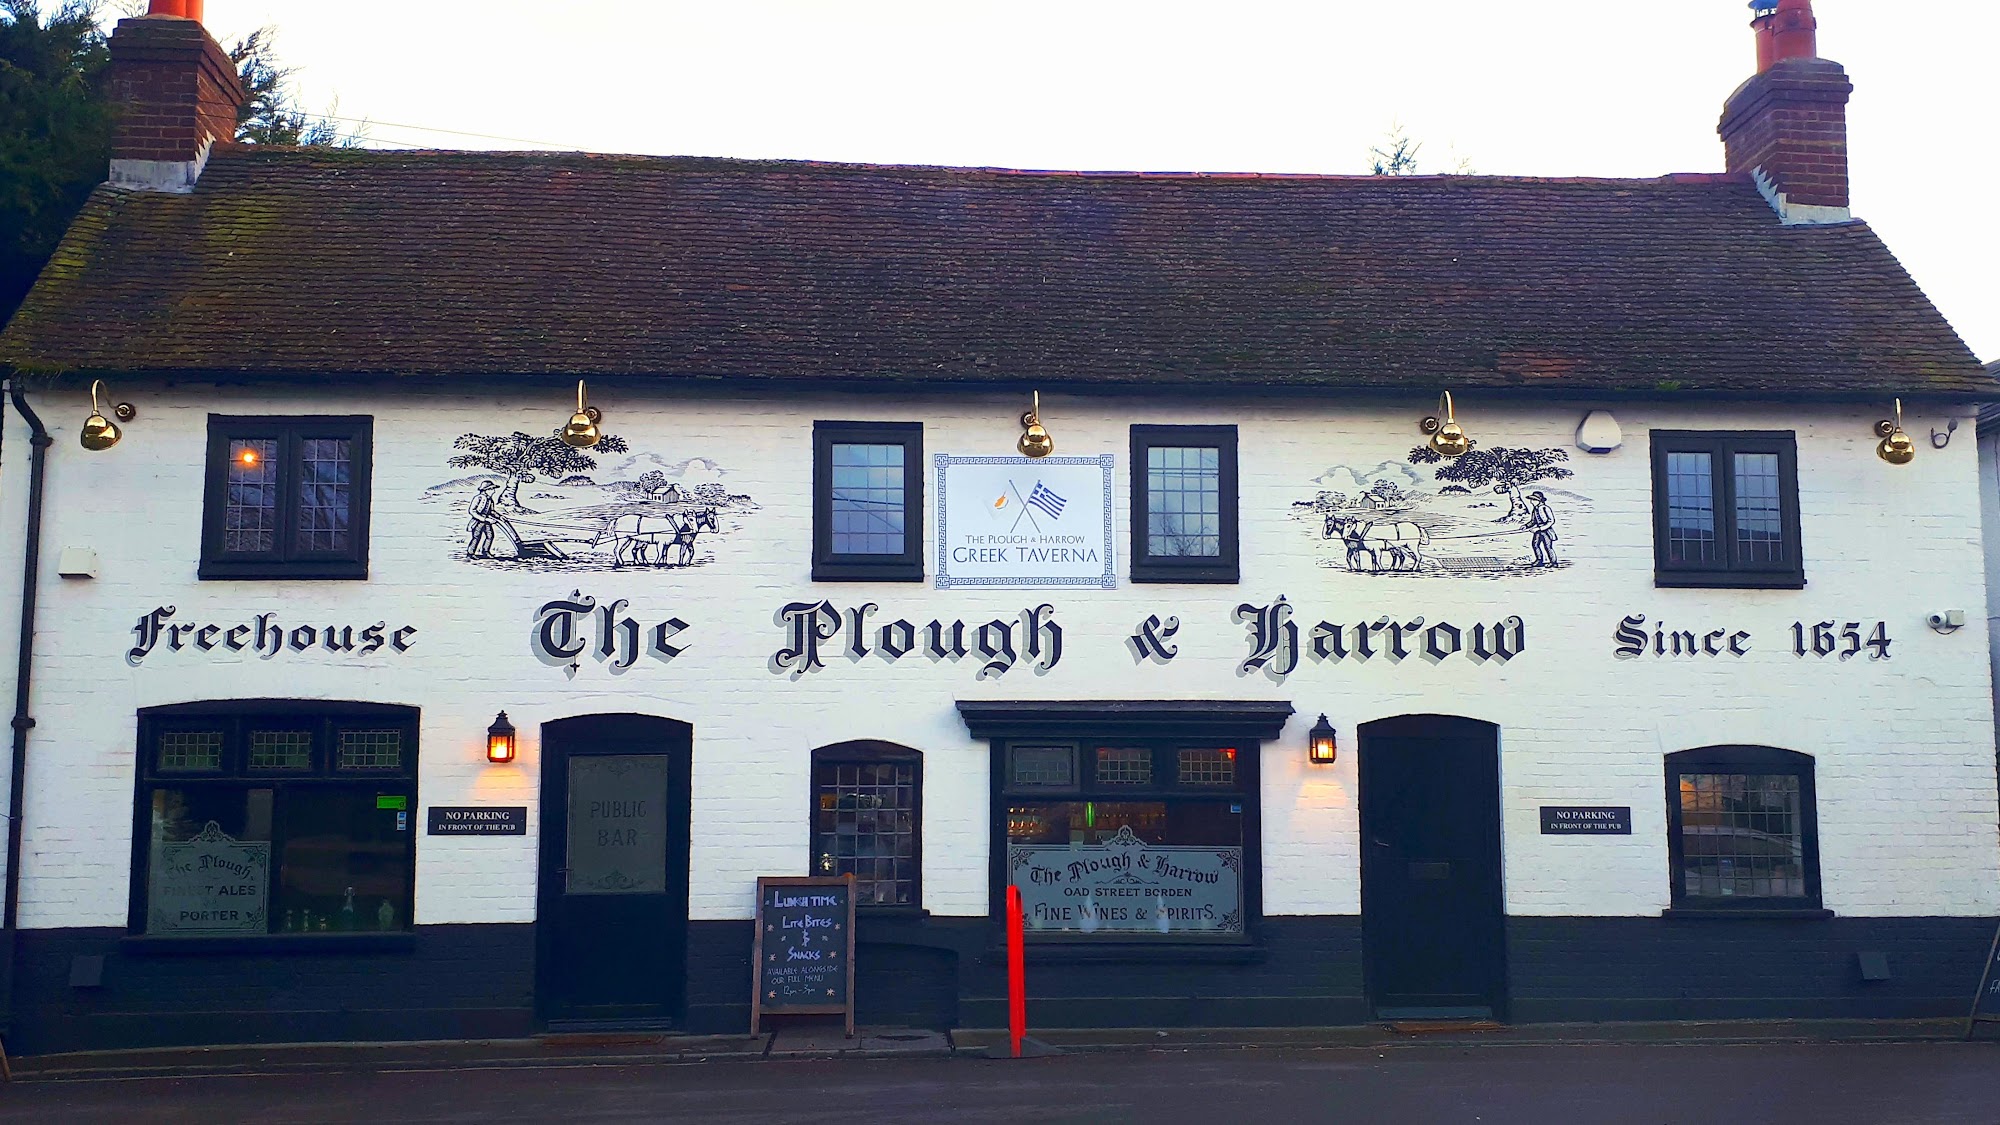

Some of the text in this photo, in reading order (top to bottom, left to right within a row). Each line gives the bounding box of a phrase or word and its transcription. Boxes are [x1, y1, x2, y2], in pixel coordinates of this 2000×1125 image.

[965, 535, 984, 544] THE
[988, 535, 1027, 544] PLOUGH
[1040, 535, 1085, 544] HARROW
[953, 547, 1098, 563] GREEK TAVERNA
[127, 604, 418, 665] Freehouse
[534, 589, 1526, 684] The Plough & Harrow
[1614, 614, 1891, 662] Since 1654
[446, 812, 510, 820] NO PARKING
[590, 800, 646, 818] PUBLIC
[1556, 811, 1615, 819] NO PARKING
[598, 829, 638, 846] BAR
[1030, 852, 1219, 886] The Plough & Harrow
[218, 886, 256, 896] ALES
[1064, 887, 1192, 897] OAD STREET BORDEN
[180, 910, 239, 921] PORTER
[1034, 903, 1071, 920] FINE
[1135, 908, 1147, 920] &
[771, 977, 784, 985] OUR
[788, 975, 801, 983] FULL
